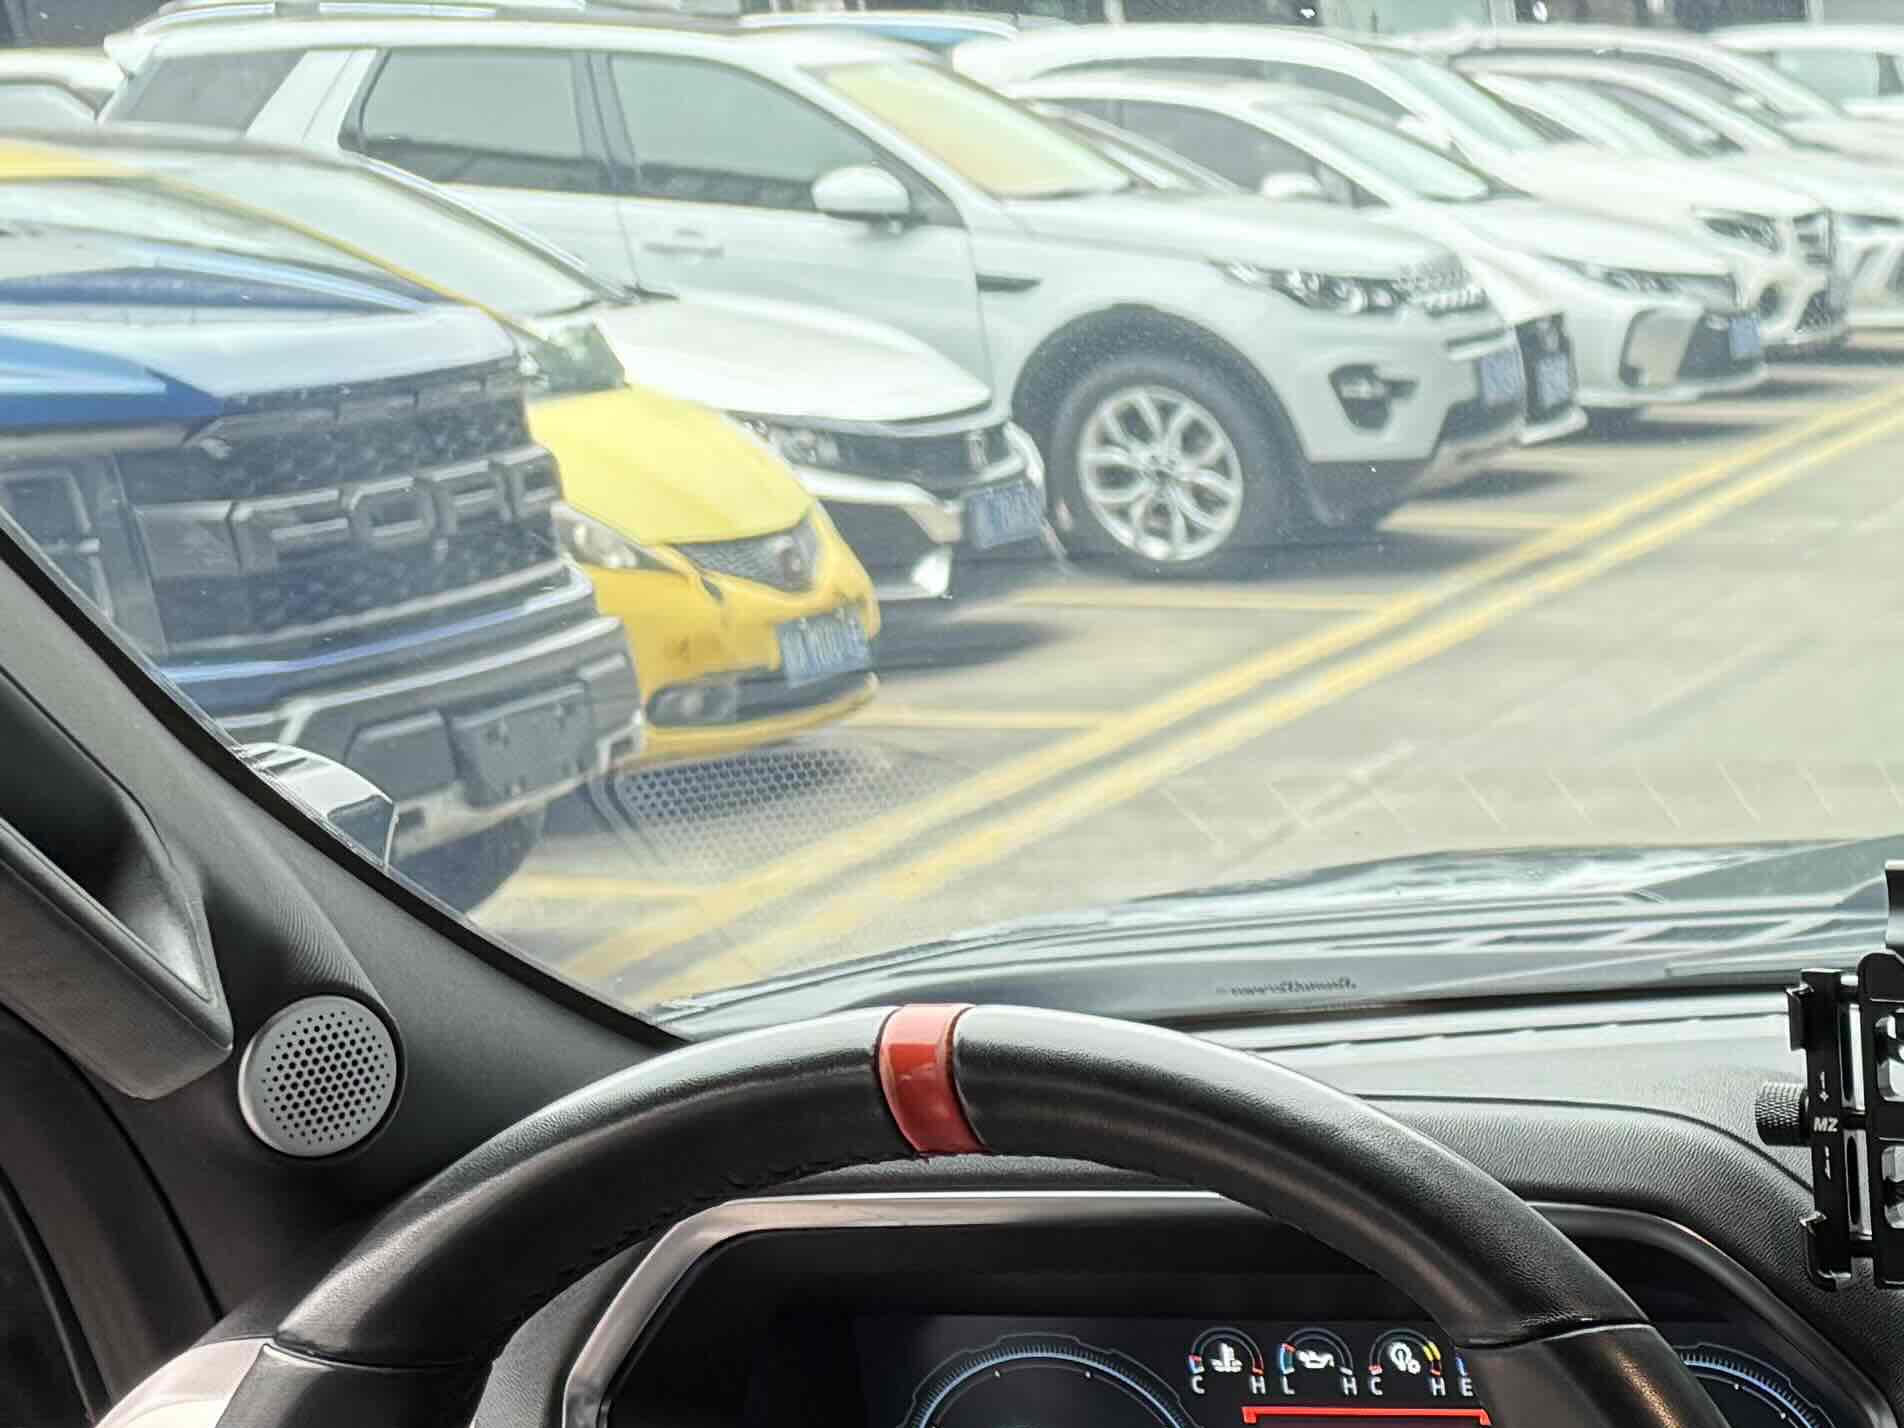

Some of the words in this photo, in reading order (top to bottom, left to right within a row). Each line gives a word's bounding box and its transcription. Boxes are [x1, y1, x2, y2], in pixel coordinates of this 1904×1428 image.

[1813, 1117, 1839, 1132] MZ
[1192, 1377, 1205, 1395] C
[1252, 1377, 1266, 1395] H
[1283, 1377, 1295, 1396] L
[1343, 1377, 1358, 1396] H
[1370, 1377, 1384, 1396] C
[1431, 1377, 1446, 1397] H
